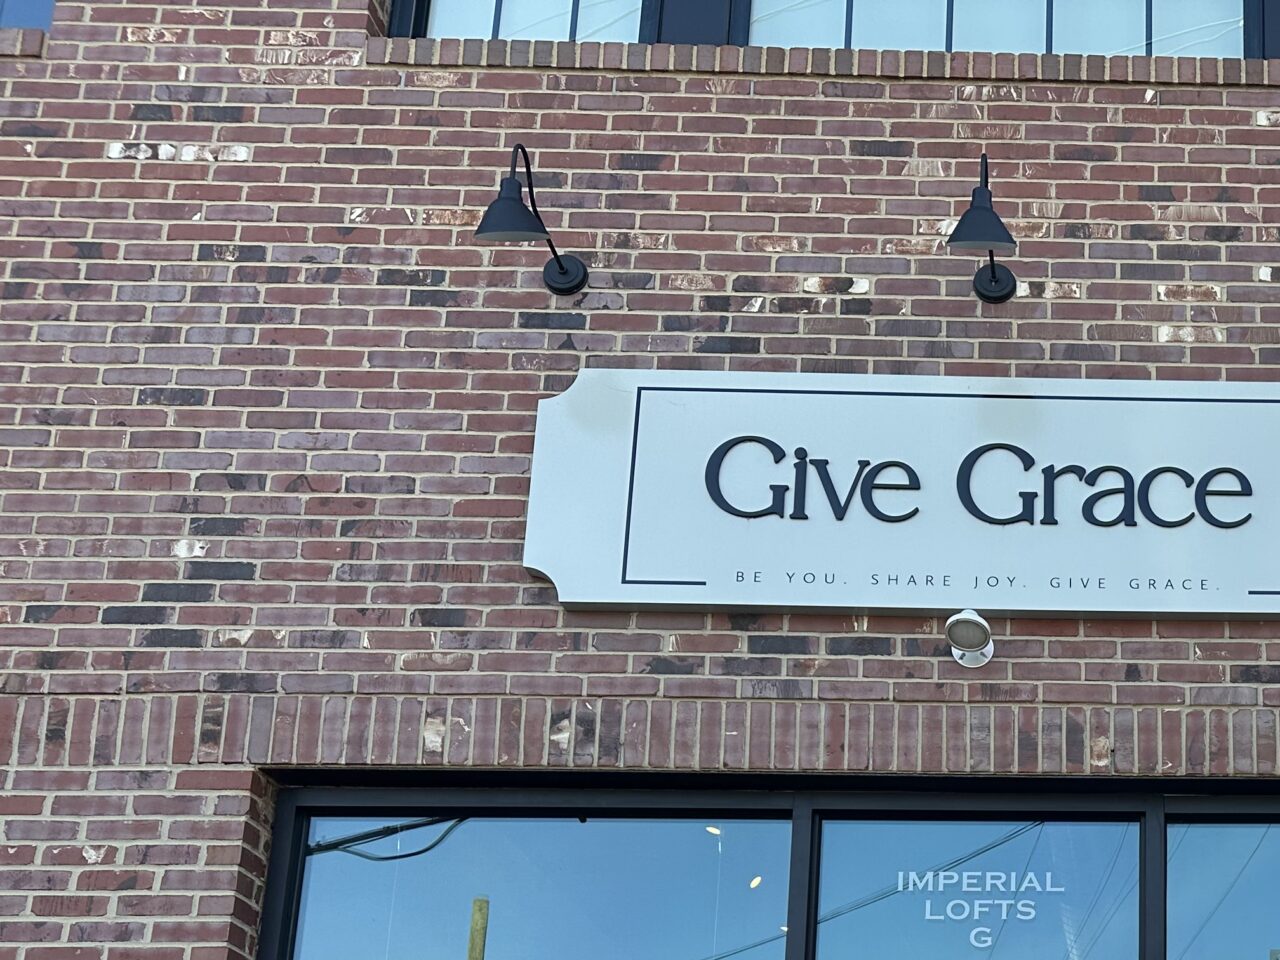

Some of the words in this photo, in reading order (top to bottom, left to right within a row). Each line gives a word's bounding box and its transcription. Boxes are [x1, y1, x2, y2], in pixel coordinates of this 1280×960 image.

[704, 435, 922, 523] Give
[956, 442, 1254, 529] Grace
[735, 570, 763, 583] BE
[785, 571, 848, 585] YOU.
[870, 573, 953, 587] SHARE
[973, 575, 1027, 589] JOY.
[1049, 576, 1107, 589] GIVE
[1128, 577, 1221, 591] GRACE.
[897, 871, 1065, 892] IMPERIAL
[924, 899, 1037, 921] LOFTS
[968, 926, 994, 949] G
